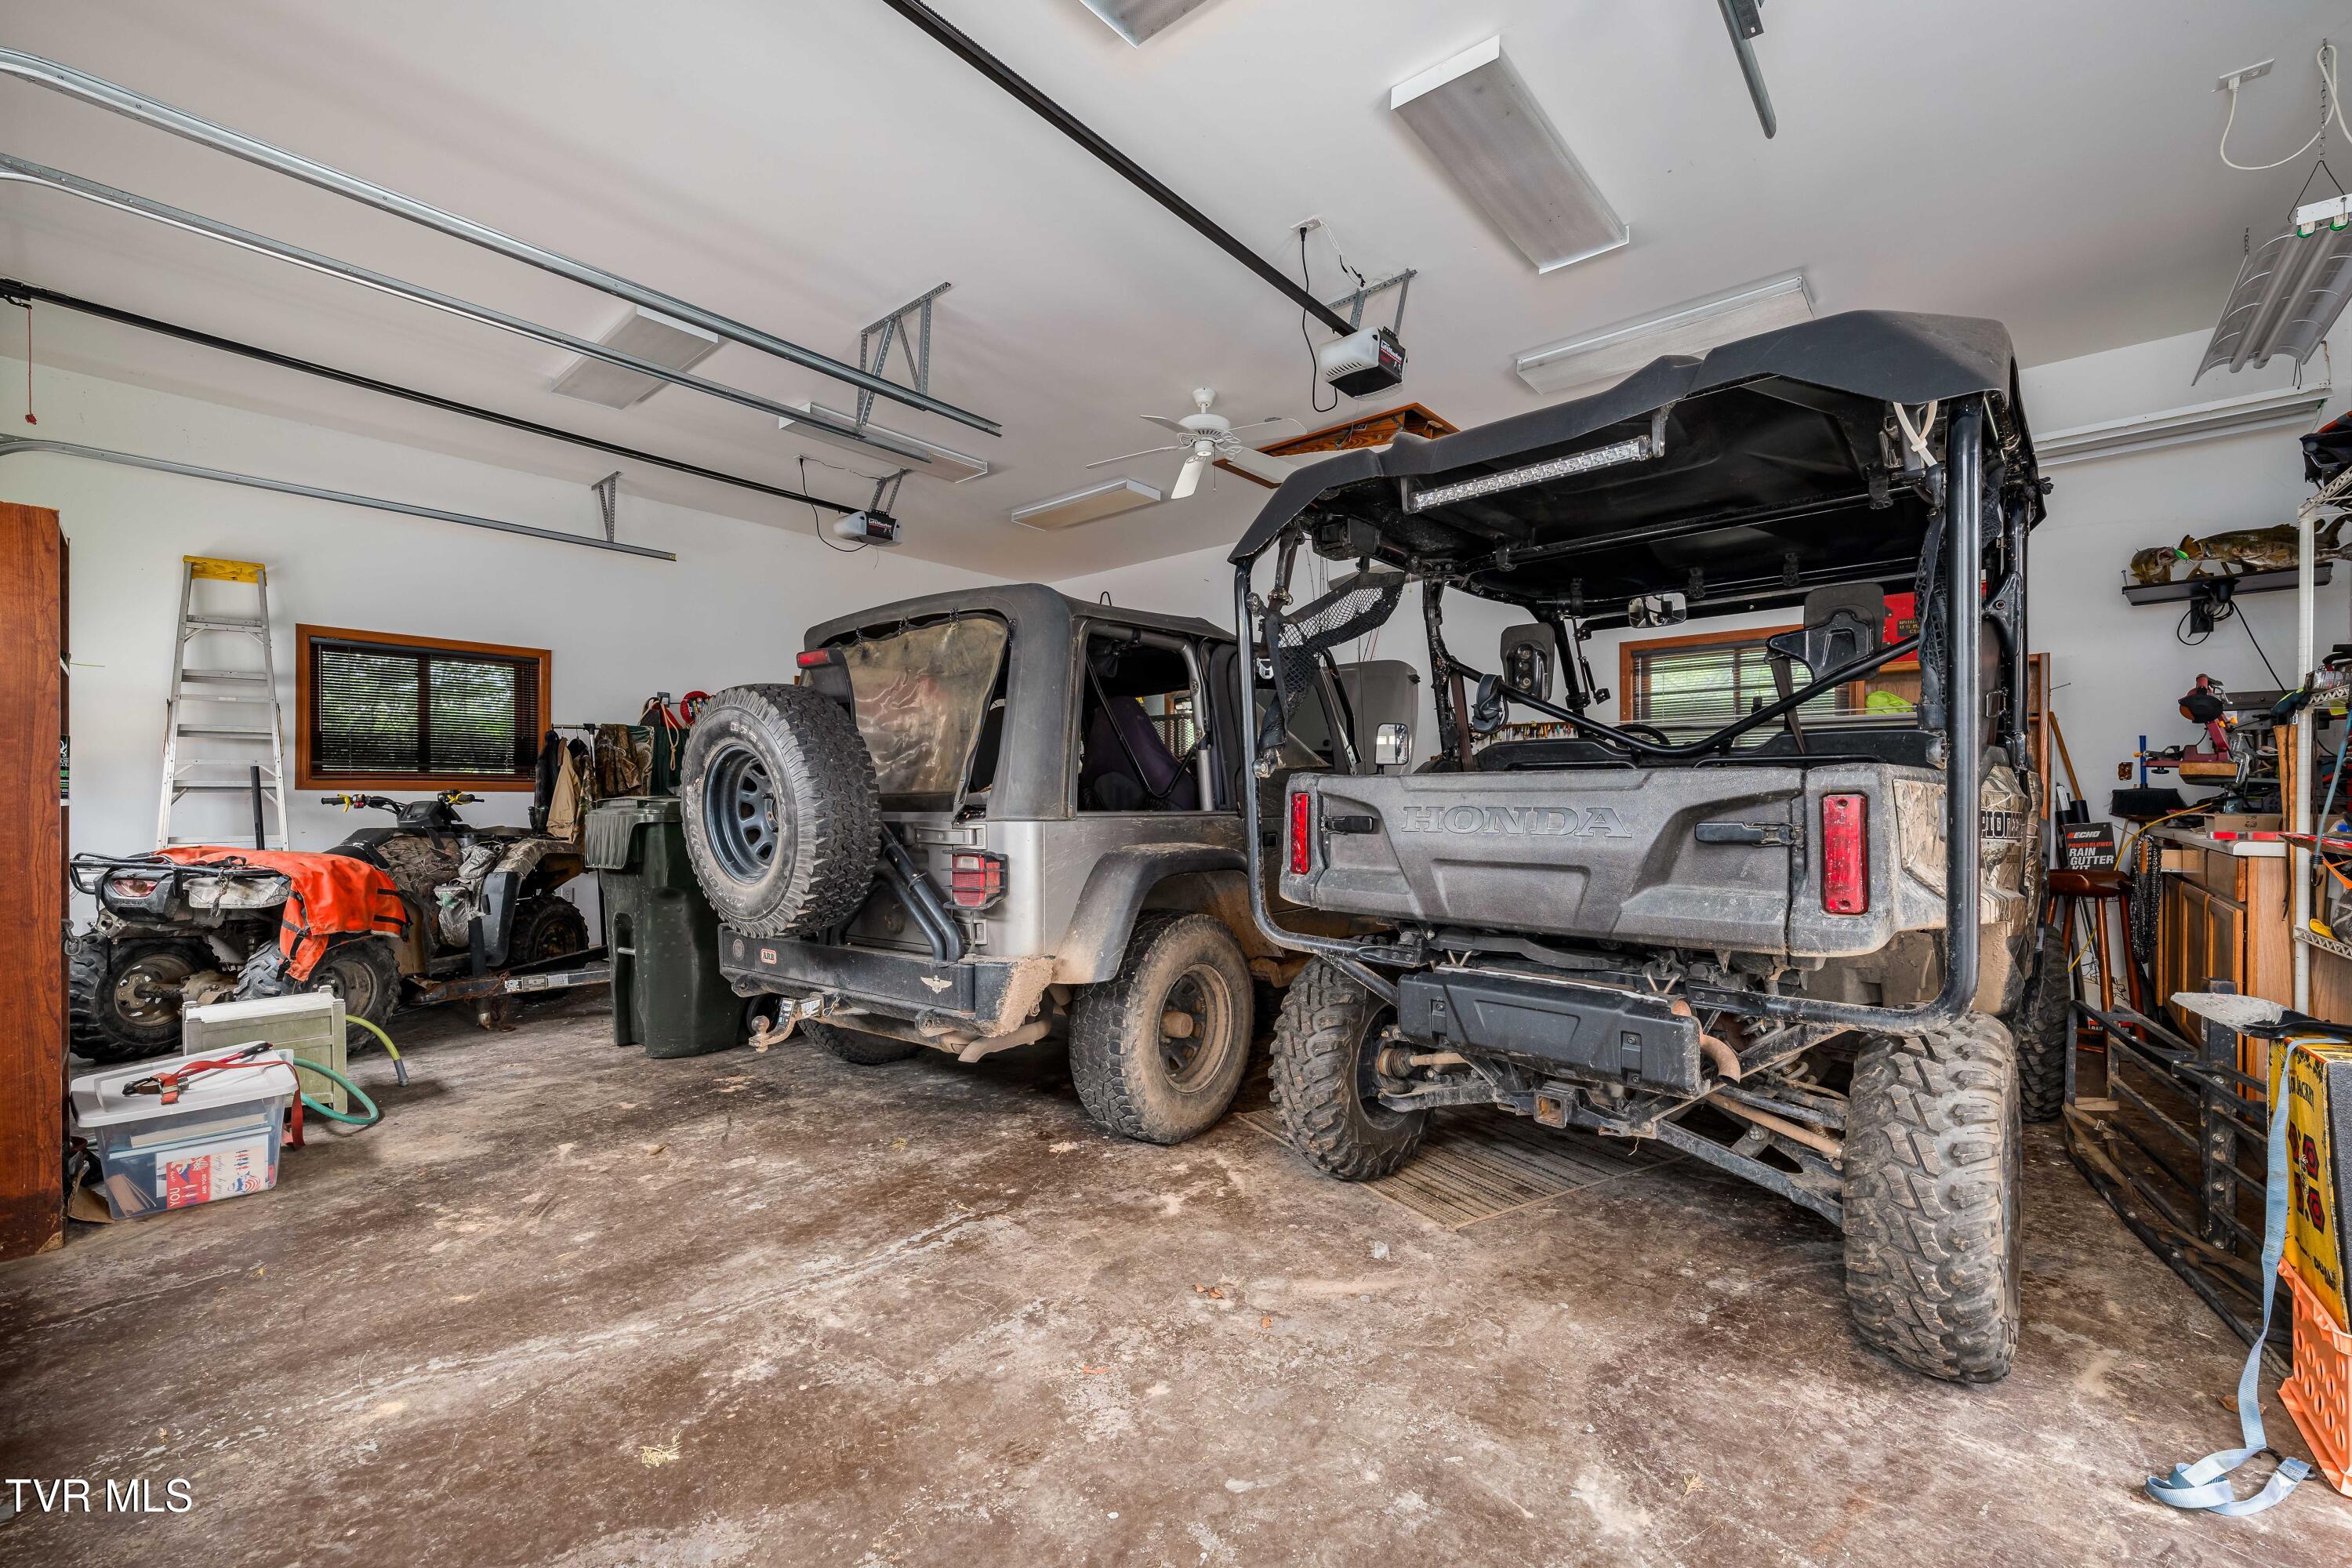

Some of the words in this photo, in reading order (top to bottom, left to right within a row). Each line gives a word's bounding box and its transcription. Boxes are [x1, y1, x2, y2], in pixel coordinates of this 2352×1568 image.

[1401, 806, 1632, 838] HONDA
[2070, 848, 2096, 856] RAIN
[2071, 855, 2114, 866] GUTTER
[169, 1188, 180, 1207] YOU
